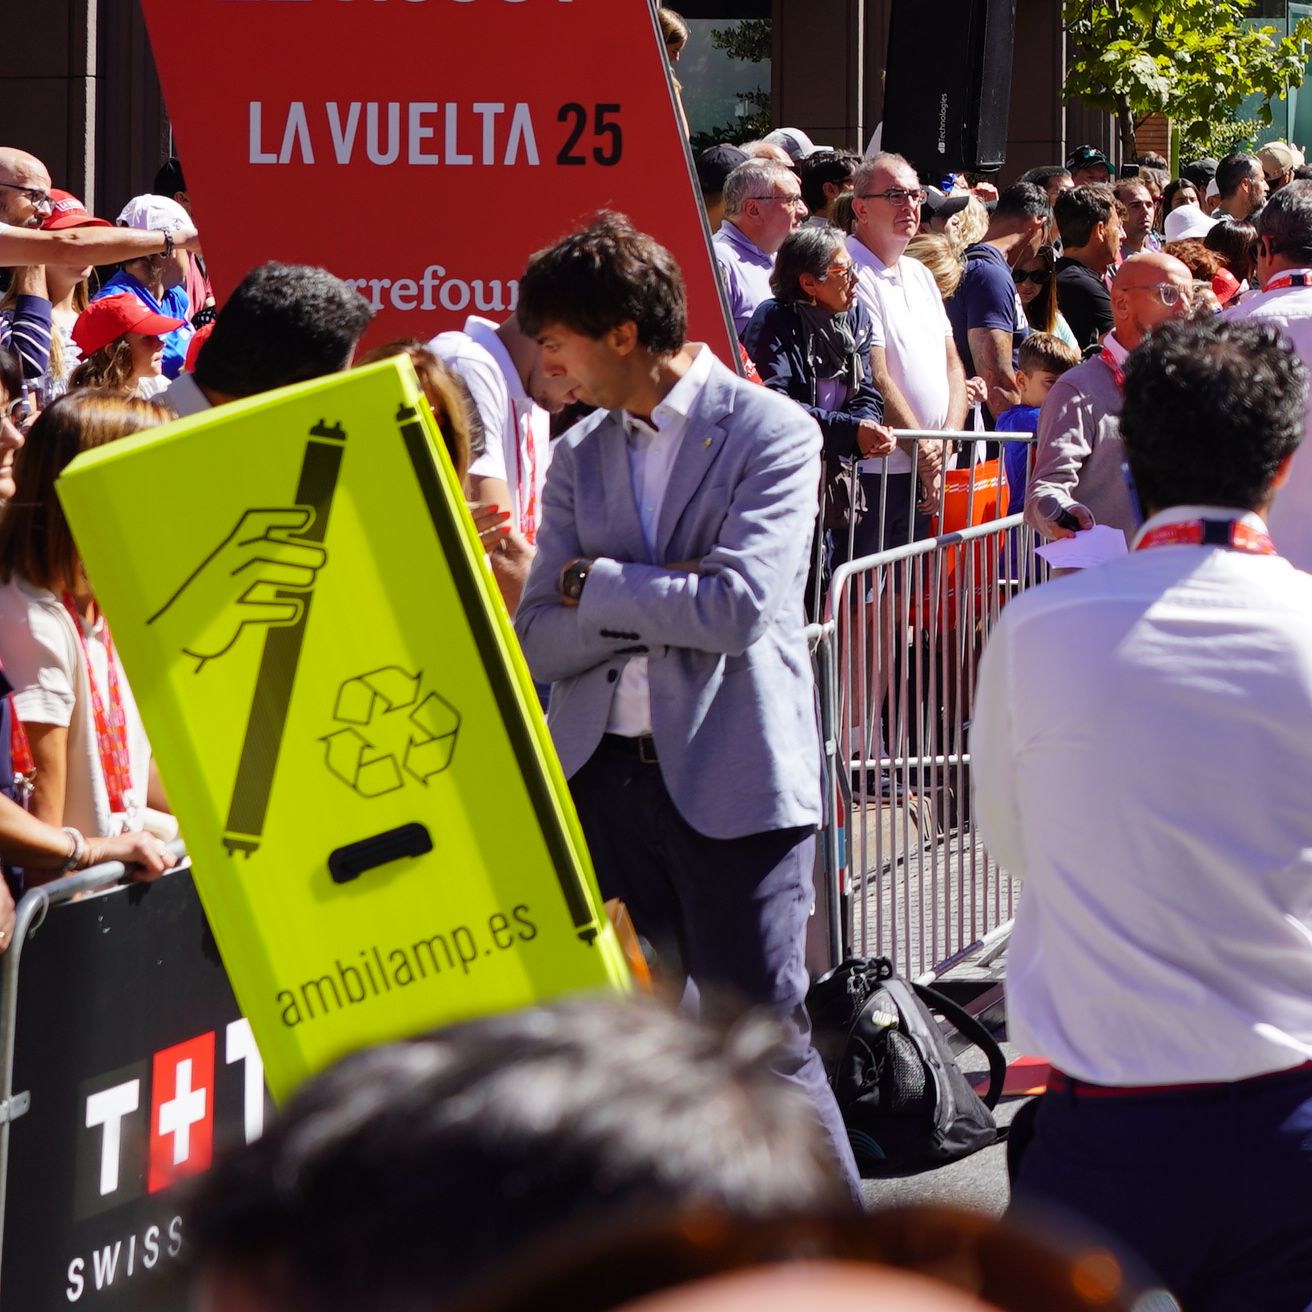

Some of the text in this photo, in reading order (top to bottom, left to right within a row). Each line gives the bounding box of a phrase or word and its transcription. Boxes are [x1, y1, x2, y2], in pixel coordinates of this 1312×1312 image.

[250, 102, 623, 166] LA VUELTA 25
[938, 93, 948, 154] dBTechnologies
[276, 904, 539, 1028] ambilamp.es
[66, 1215, 183, 1303] SWISS
